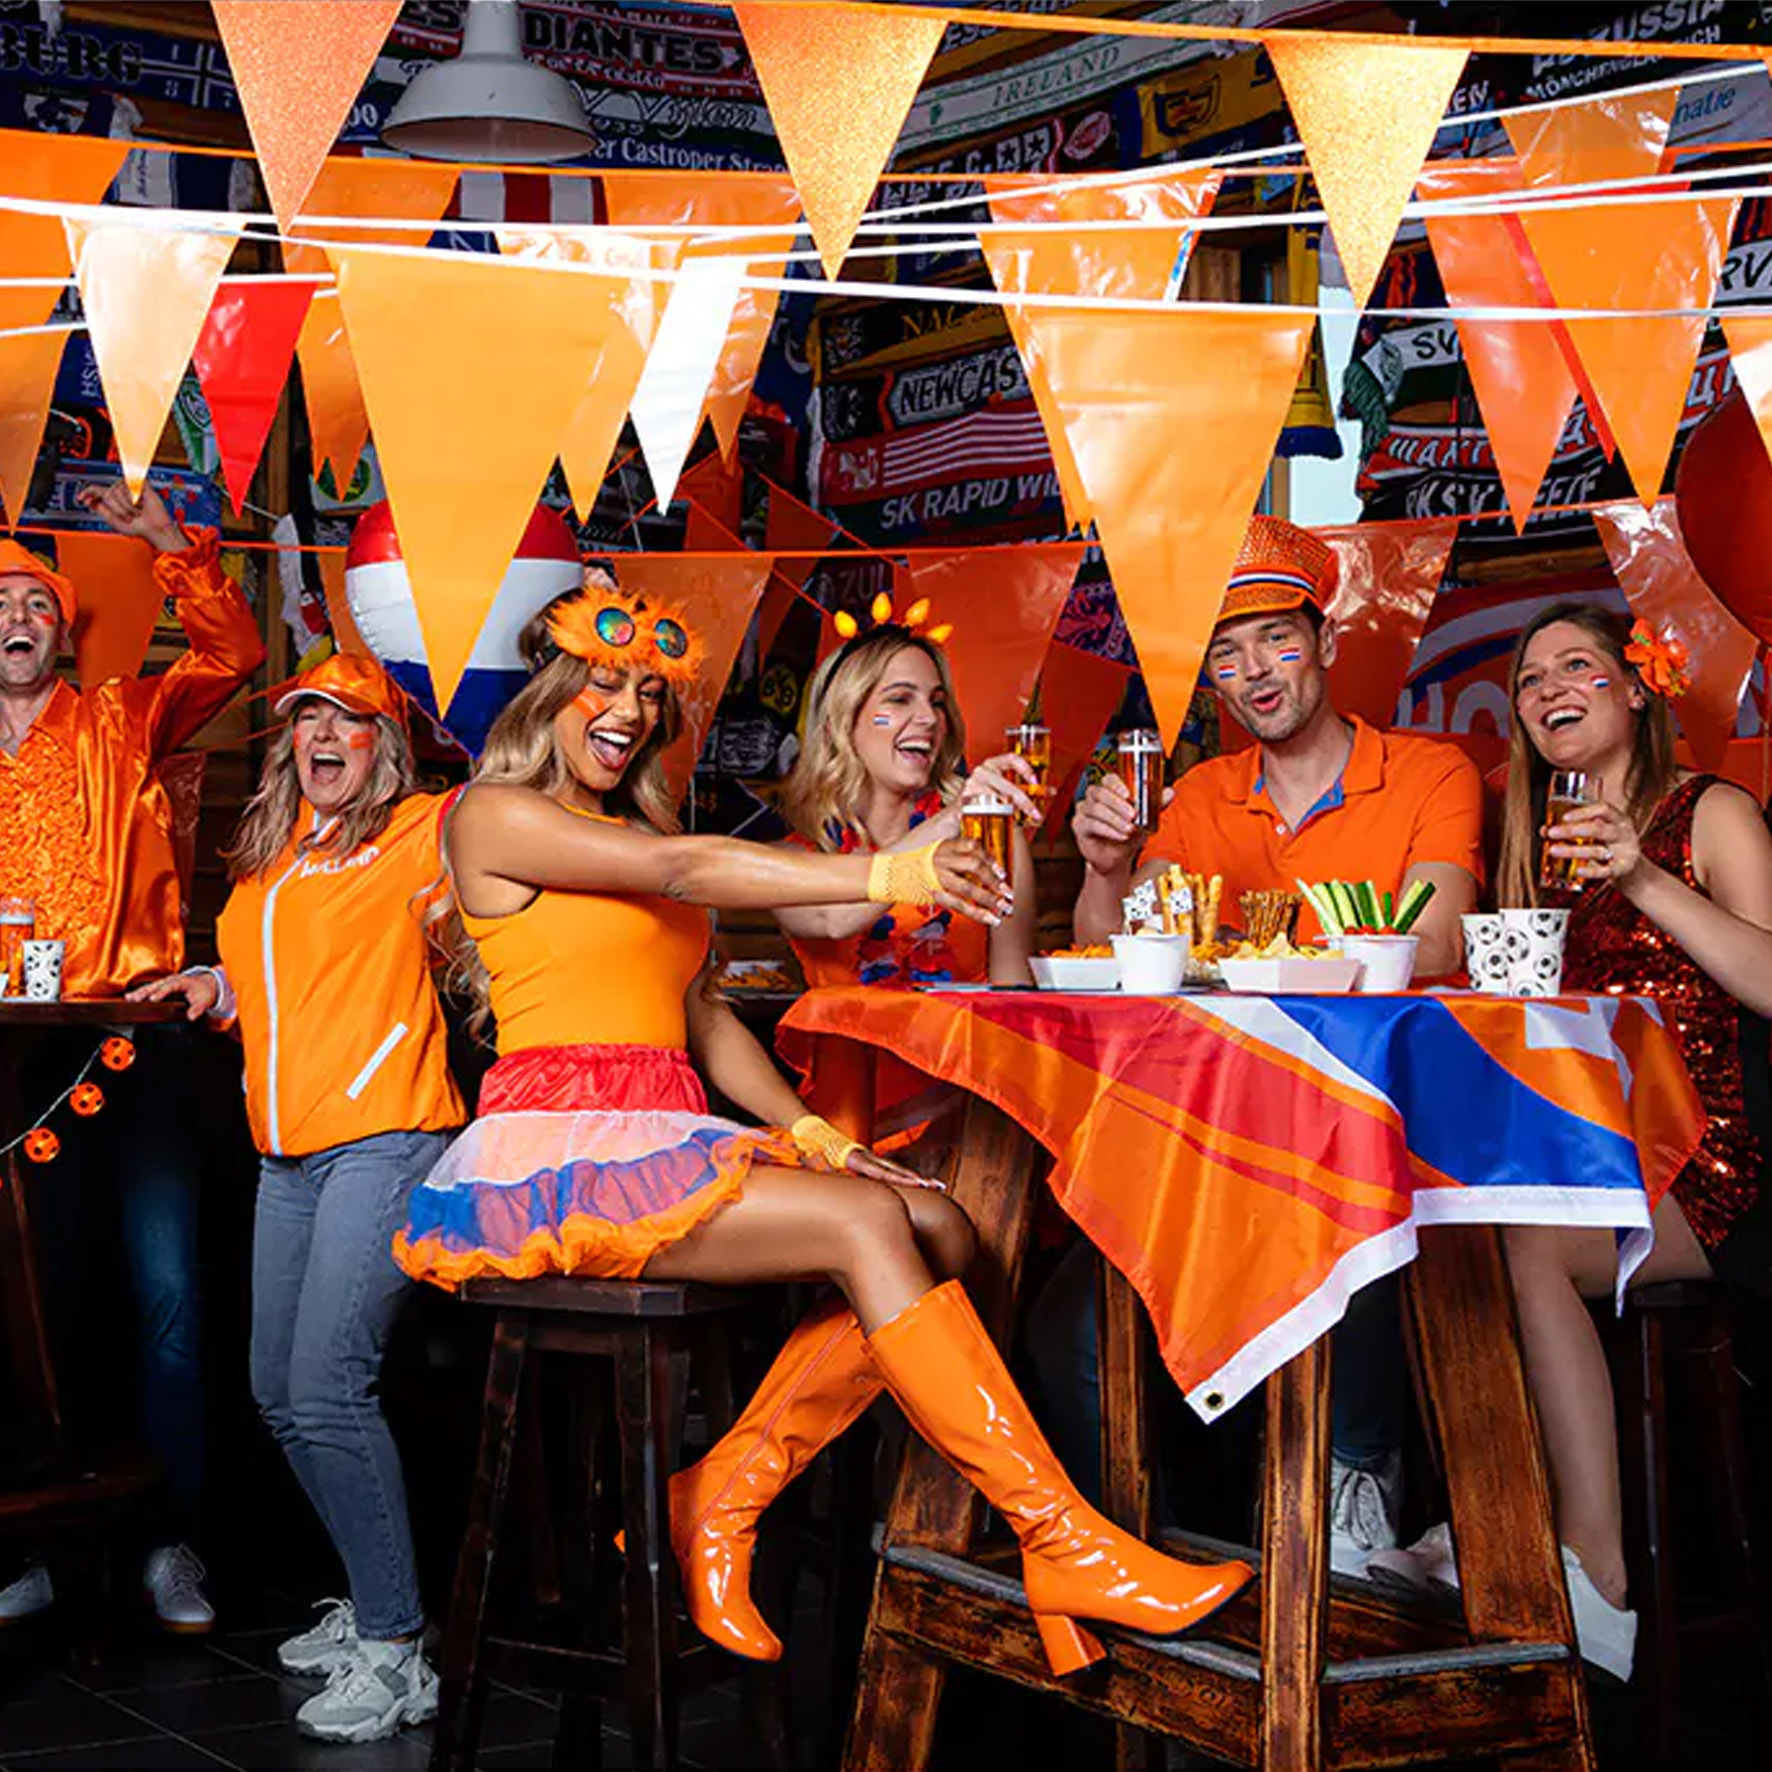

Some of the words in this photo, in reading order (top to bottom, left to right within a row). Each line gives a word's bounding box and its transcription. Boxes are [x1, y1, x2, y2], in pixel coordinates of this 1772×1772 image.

[991, 46, 1120, 108] IRELAND
[899, 354, 1028, 416] NEWCAS
[880, 493, 916, 531] SK
[923, 477, 1008, 520] RAPID
